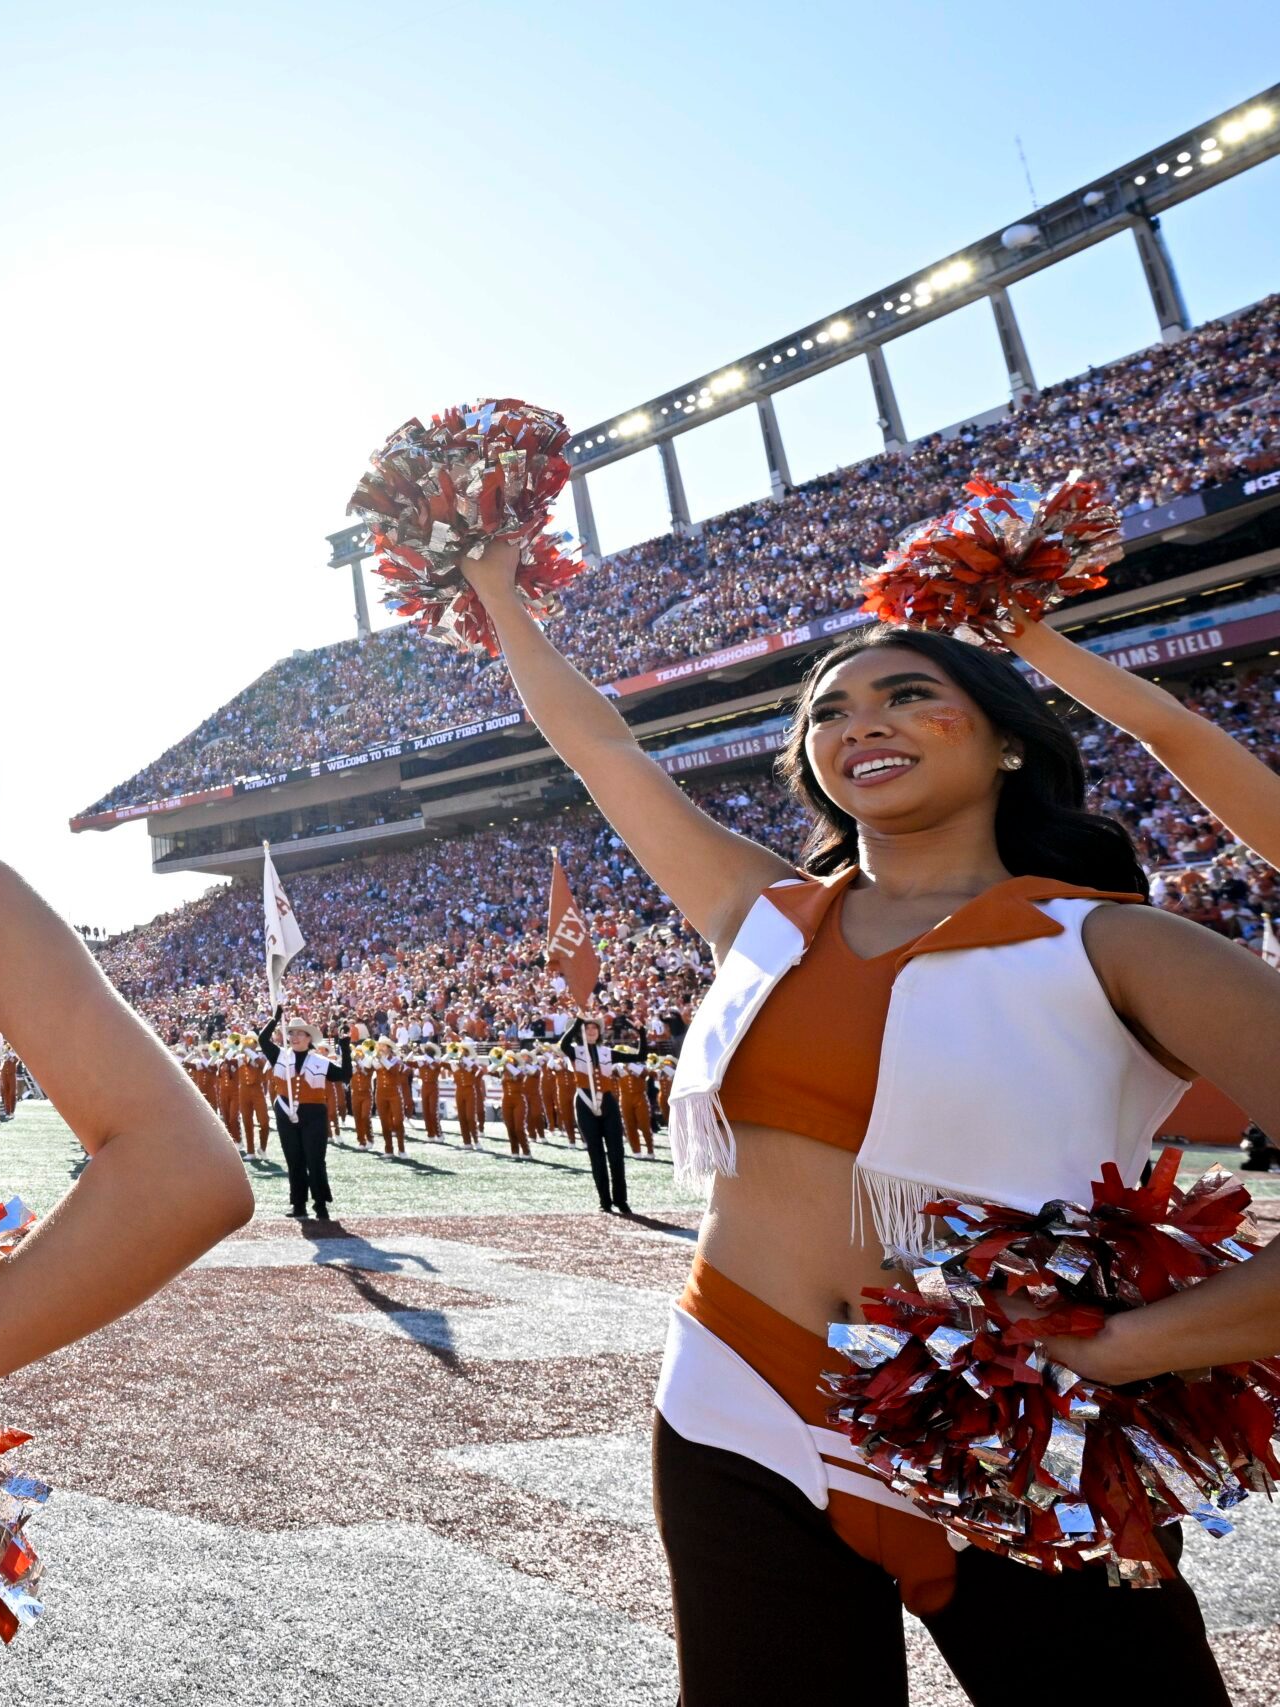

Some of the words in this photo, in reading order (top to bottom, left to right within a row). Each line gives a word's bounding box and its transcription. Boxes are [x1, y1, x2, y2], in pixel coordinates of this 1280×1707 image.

[655, 664, 693, 682] TEXAS
[694, 640, 769, 672] LONGHORNS
[780, 625, 811, 648] 17:36
[1167, 630, 1223, 657] FIELD
[327, 754, 369, 772] WELCOME
[369, 751, 382, 761] TO
[382, 745, 402, 759] THE
[414, 731, 454, 750] PLAYOFF
[455, 722, 484, 740] FIRST
[485, 712, 520, 731] ROUND
[677, 752, 712, 770] ROYAL
[724, 739, 761, 759] TEXAS
